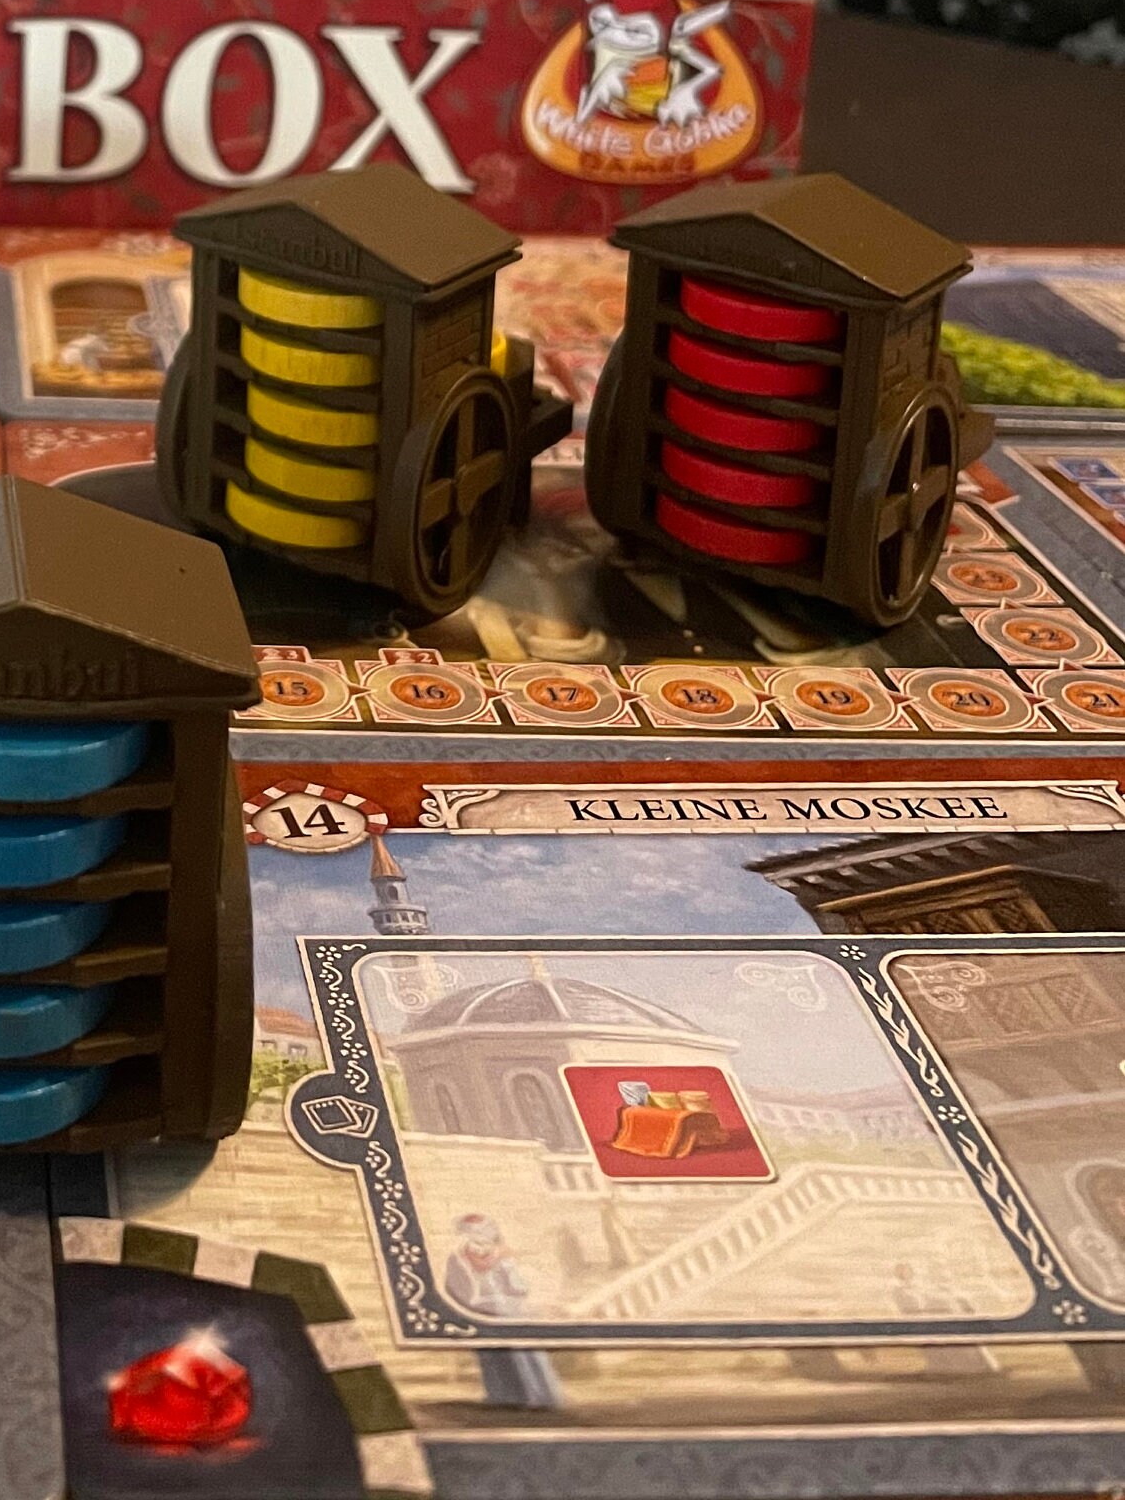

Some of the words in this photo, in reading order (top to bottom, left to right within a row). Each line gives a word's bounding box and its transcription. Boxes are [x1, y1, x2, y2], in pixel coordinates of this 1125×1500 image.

[5, 17, 484, 194] BOX
[274, 680, 309, 697] 15
[410, 683, 447, 700] 16
[546, 686, 579, 702] 17
[810, 689, 854, 706] 19
[1079, 691, 1121, 709] 21
[563, 799, 769, 821] KLEINE
[775, 796, 1009, 822] MOSKEE
[270, 803, 349, 839] 14
